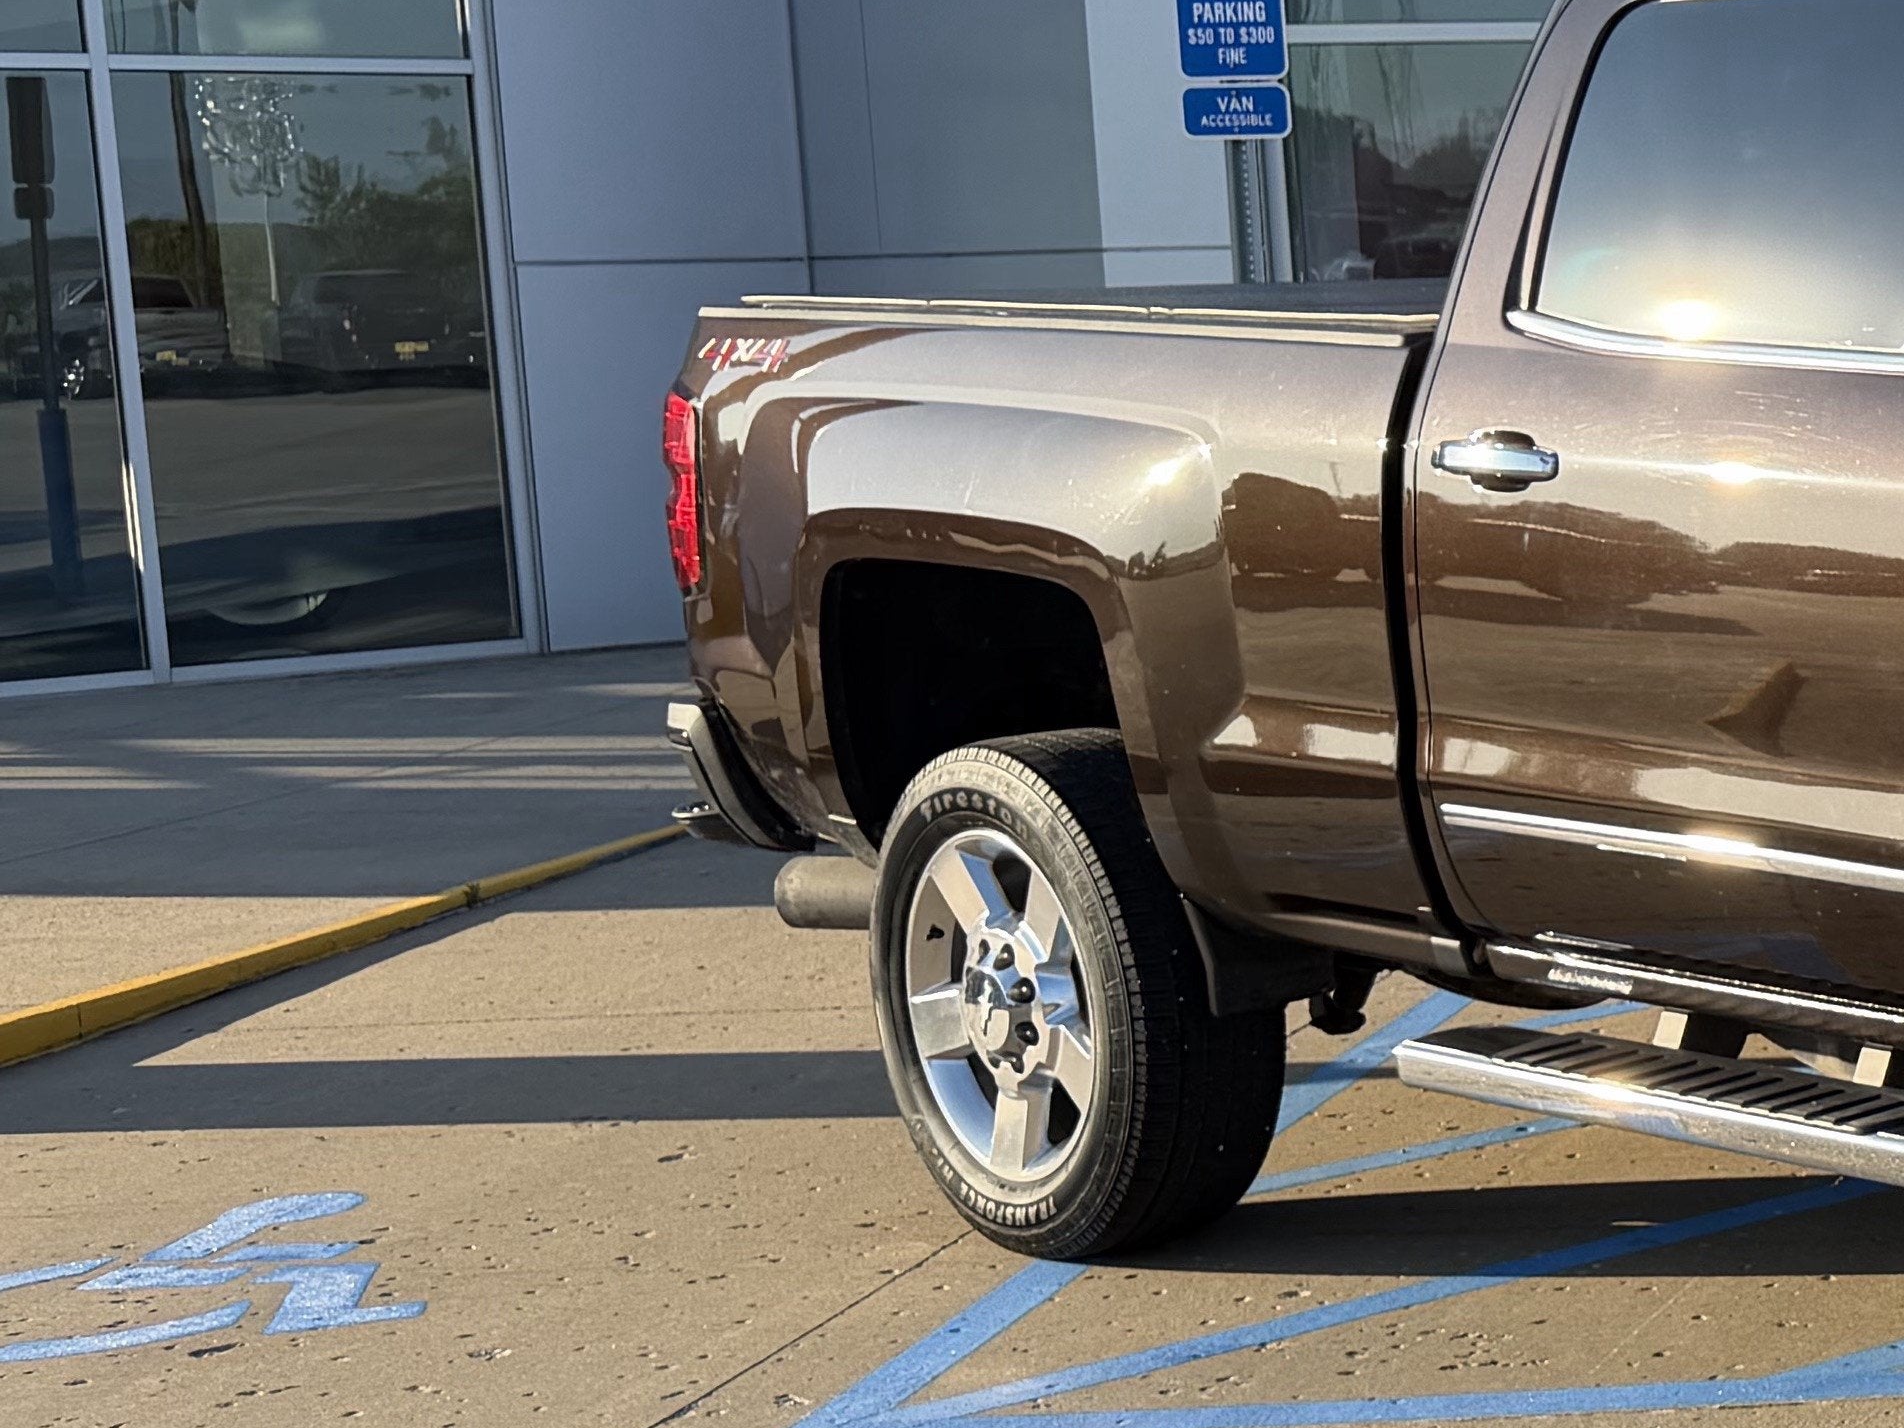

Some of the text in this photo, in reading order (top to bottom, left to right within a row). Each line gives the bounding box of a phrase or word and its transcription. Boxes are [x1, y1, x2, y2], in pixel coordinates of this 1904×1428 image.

[1192, 1, 1266, 23] PARKING
[1188, 26, 1275, 45] $50 TO $300
[1218, 47, 1247, 65] FINE
[1217, 96, 1254, 113] VAN
[1201, 114, 1273, 128] ACCESSIBLE
